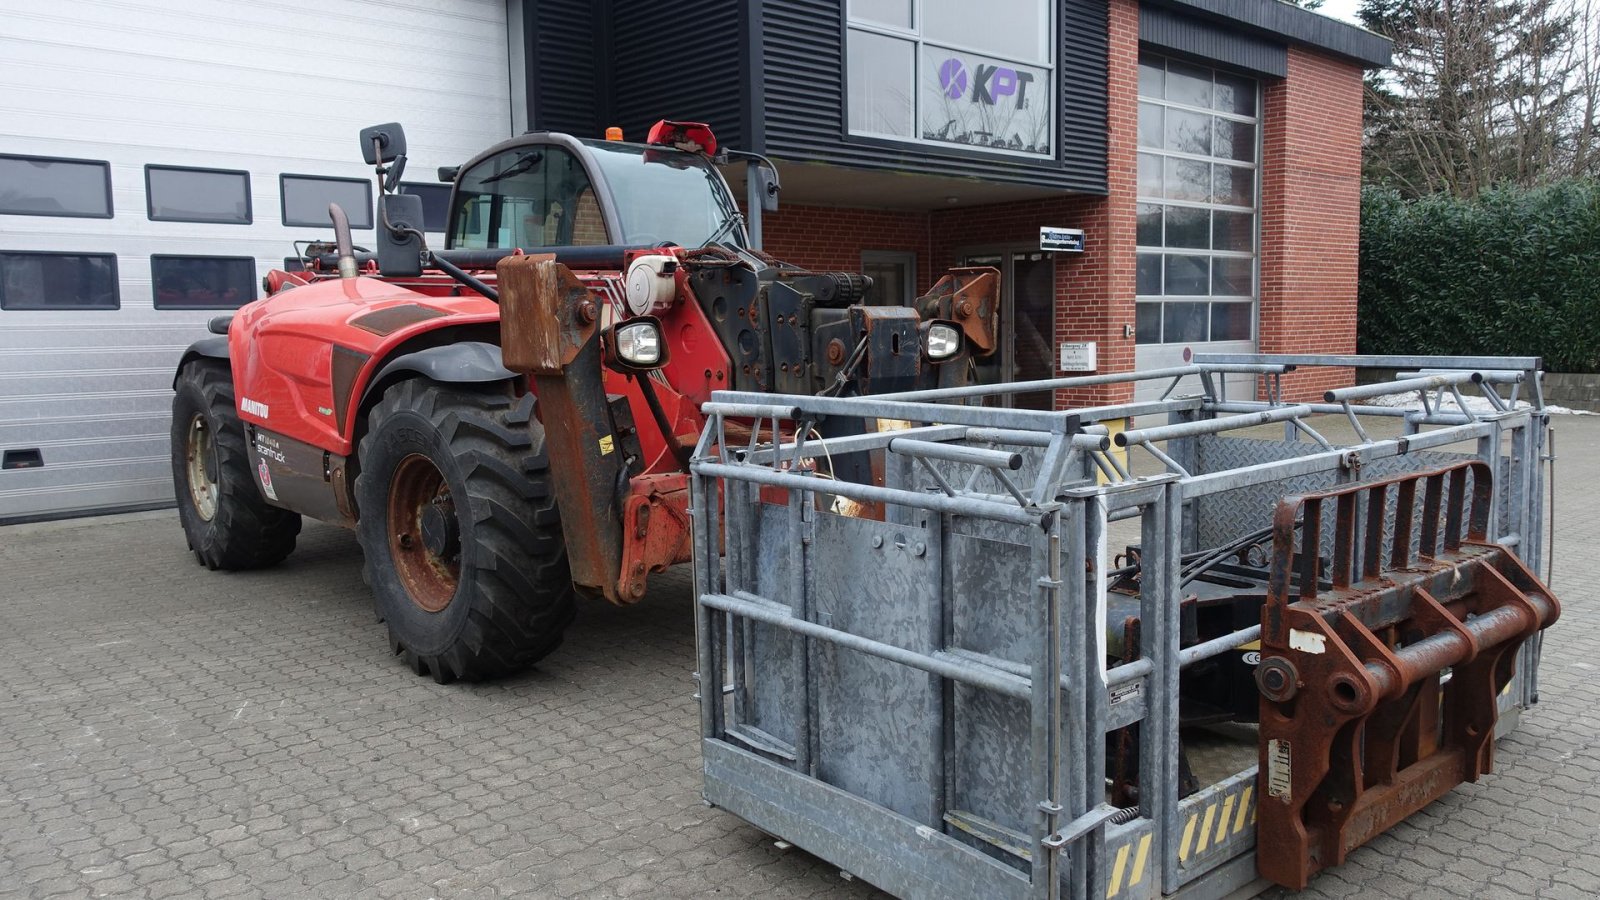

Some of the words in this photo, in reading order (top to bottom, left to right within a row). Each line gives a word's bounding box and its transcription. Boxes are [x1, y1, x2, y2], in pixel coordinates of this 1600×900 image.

[972, 64, 1034, 110] KPT
[241, 397, 269, 419] MANITOU
[257, 444, 286, 463] scantruck
